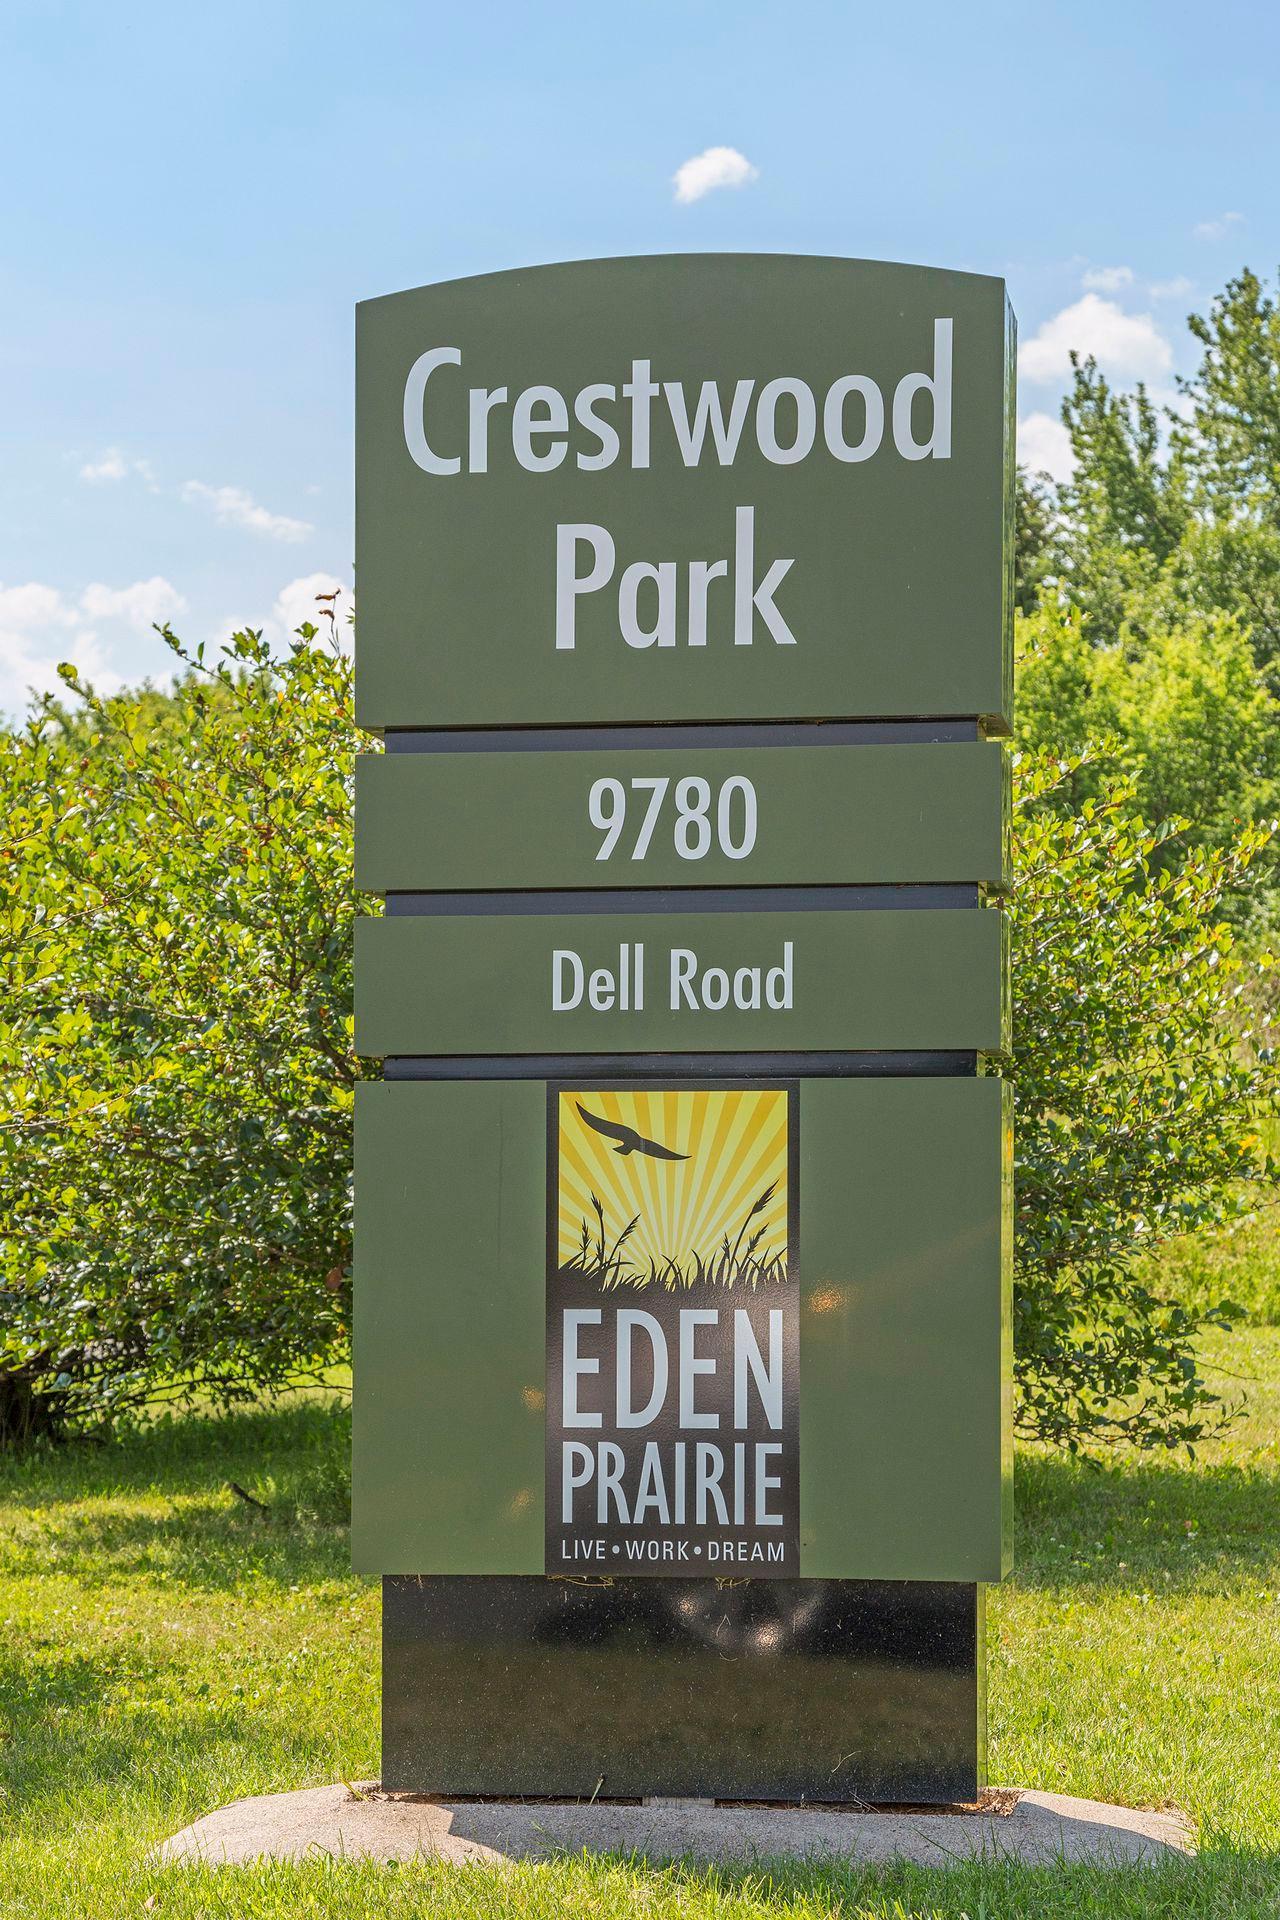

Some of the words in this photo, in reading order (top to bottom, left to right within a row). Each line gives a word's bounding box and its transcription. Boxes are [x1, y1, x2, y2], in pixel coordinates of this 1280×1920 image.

[403, 317, 954, 476] Crestwood
[555, 505, 798, 650] Park
[588, 775, 758, 862] 9780
[552, 943, 644, 1012] Dell
[670, 941, 794, 1011] Road
[562, 1308, 783, 1430] EDEN
[562, 1441, 784, 1526] PRAIRIE
[562, 1539, 606, 1560] LIVE
[625, 1540, 690, 1561] WORK
[708, 1541, 785, 1562] DREAM
